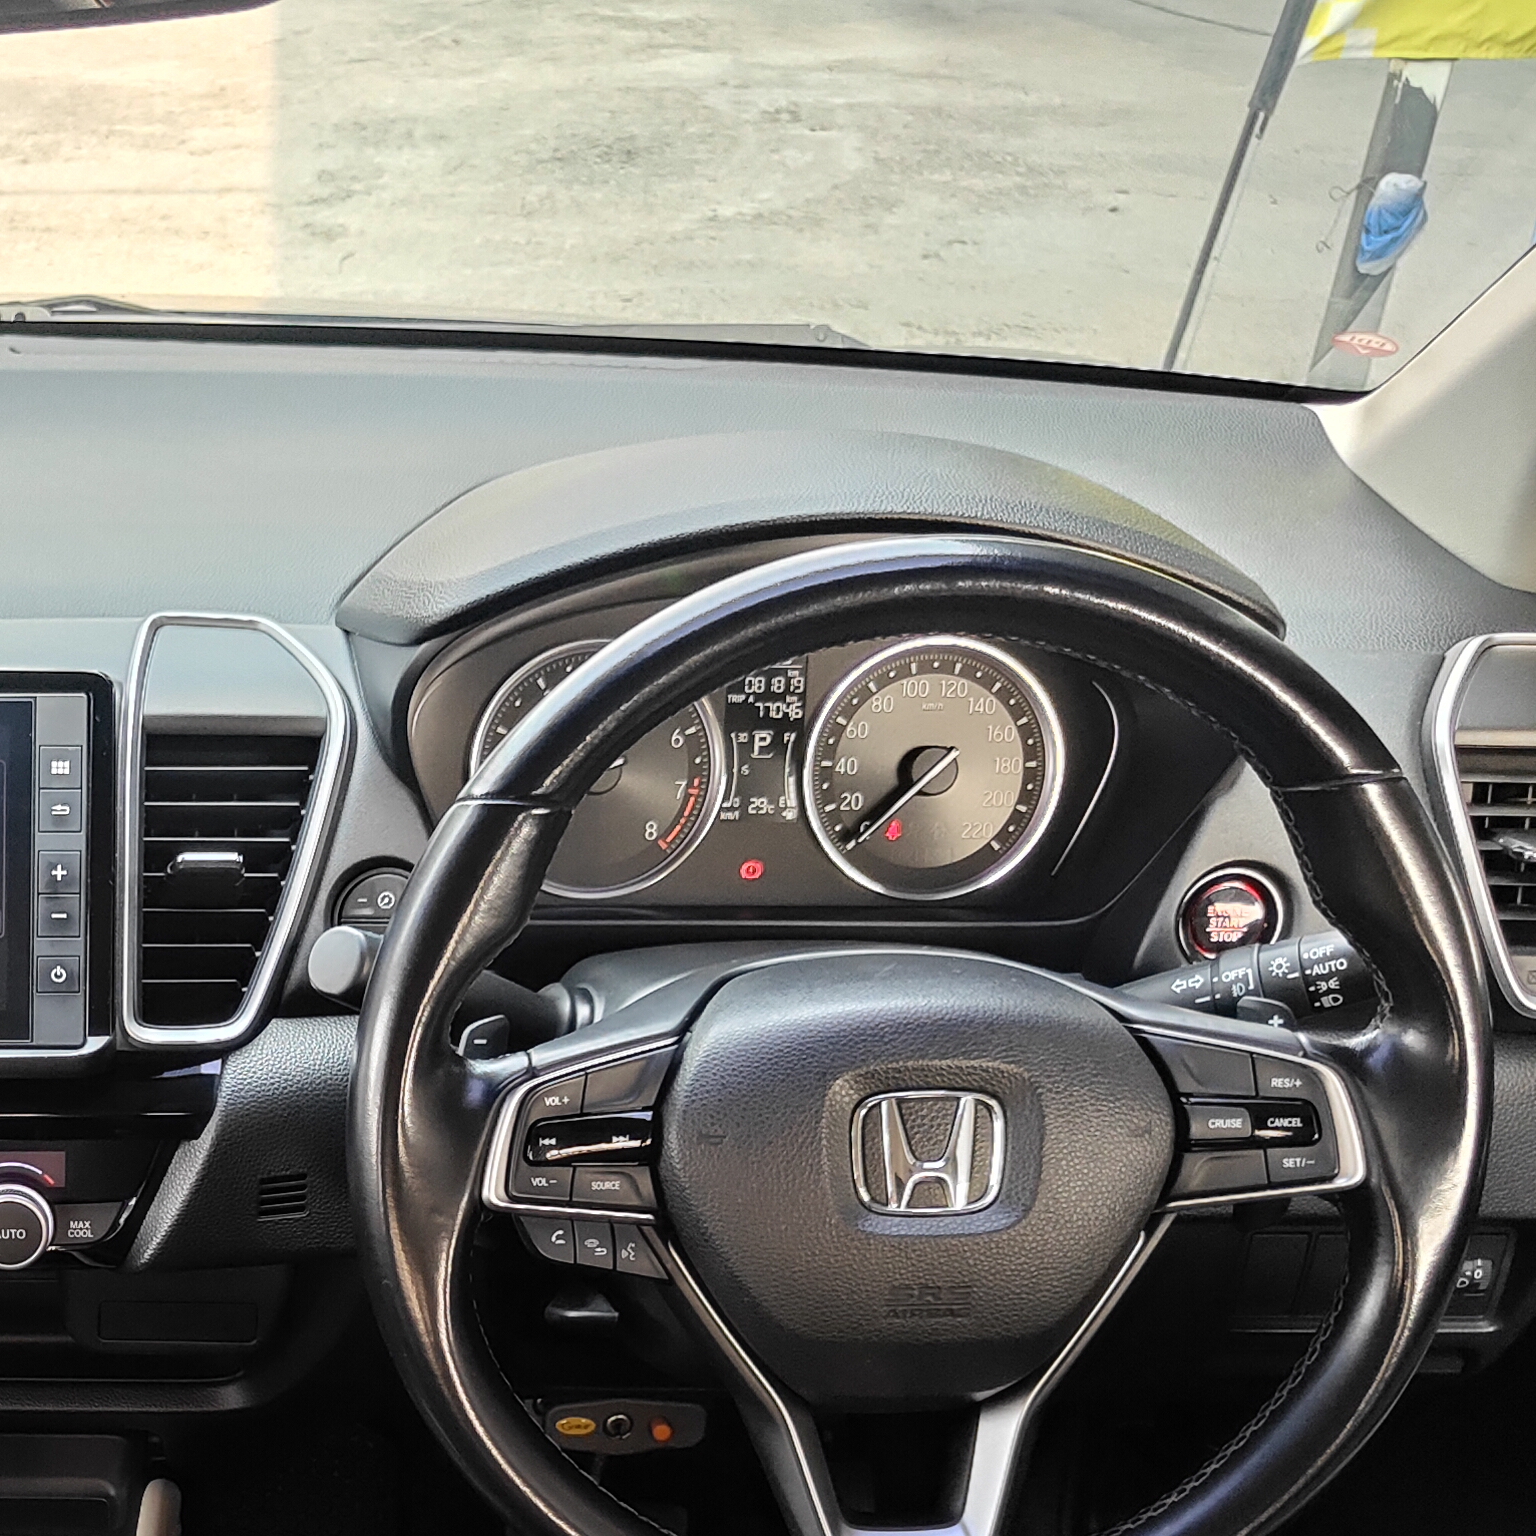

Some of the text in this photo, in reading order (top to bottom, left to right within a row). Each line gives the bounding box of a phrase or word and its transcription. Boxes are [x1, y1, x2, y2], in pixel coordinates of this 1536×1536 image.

[901, 680, 929, 698] 100
[940, 680, 968, 698] 120
[727, 694, 754, 704] TRIP A
[871, 696, 894, 713] 80
[922, 702, 944, 711] km/h
[968, 698, 996, 715] 140
[670, 726, 684, 749] 6
[846, 721, 869, 739] 60
[987, 725, 1015, 742] 160
[753, 733, 772, 756] P
[834, 757, 858, 775] 40
[994, 757, 1022, 774] 180
[674, 780, 688, 800] 7
[778, 796, 786, 808] E
[839, 793, 862, 811] 20
[982, 790, 1014, 808] 200
[644, 820, 658, 841] 8
[962, 821, 993, 839] 220
[1208, 916, 1244, 928] START
[1210, 931, 1244, 942] STOP
[1310, 944, 1334, 958] OFF
[1222, 967, 1246, 982] OFF
[1312, 958, 1348, 976] AUTO
[1208, 1118, 1242, 1129] CRUISE
[1267, 1118, 1303, 1128] CANCEL
[591, 1181, 621, 1191] SOURCE
[70, 1220, 91, 1229] MAX
[67, 1229, 94, 1238] COOL
